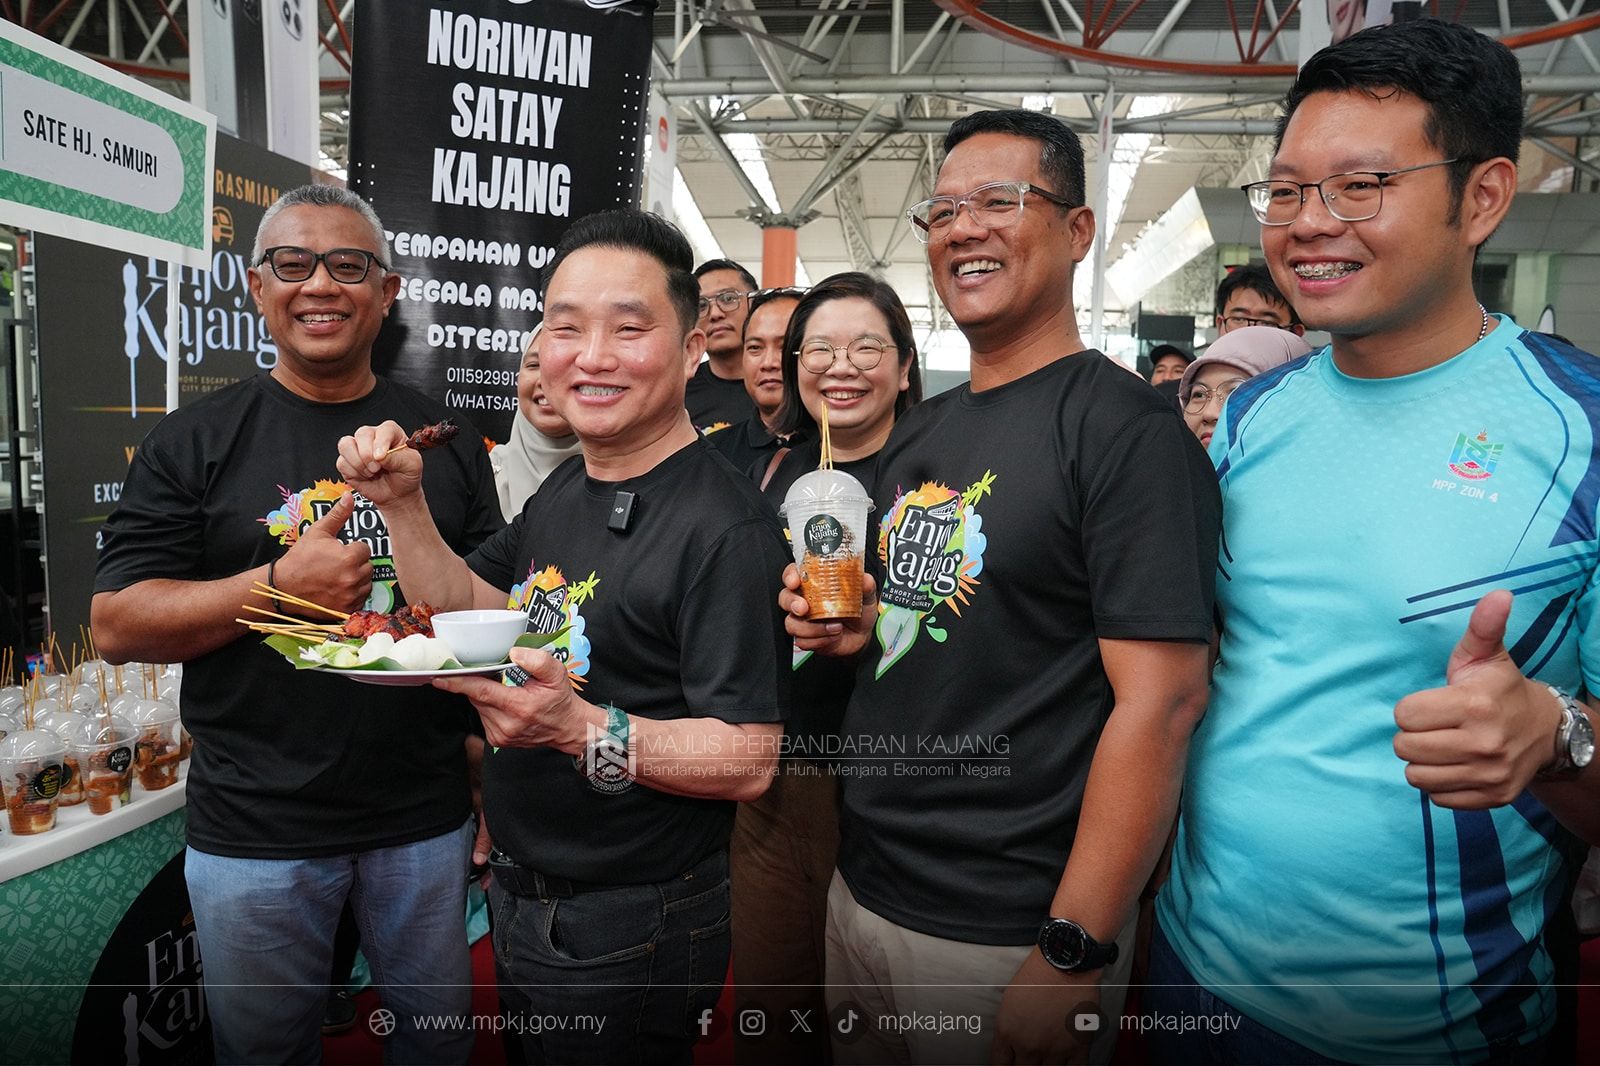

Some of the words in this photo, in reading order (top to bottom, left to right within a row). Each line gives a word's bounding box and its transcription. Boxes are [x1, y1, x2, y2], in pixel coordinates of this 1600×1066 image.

[427, 8, 592, 89] NORIWAN
[23, 109, 67, 148] SATE
[73, 126, 97, 158] HJ.
[103, 137, 158, 178] SAMURI
[450, 82, 563, 149] SATAY
[215, 168, 279, 208] RASMIAN
[431, 148, 571, 218] KAJANG
